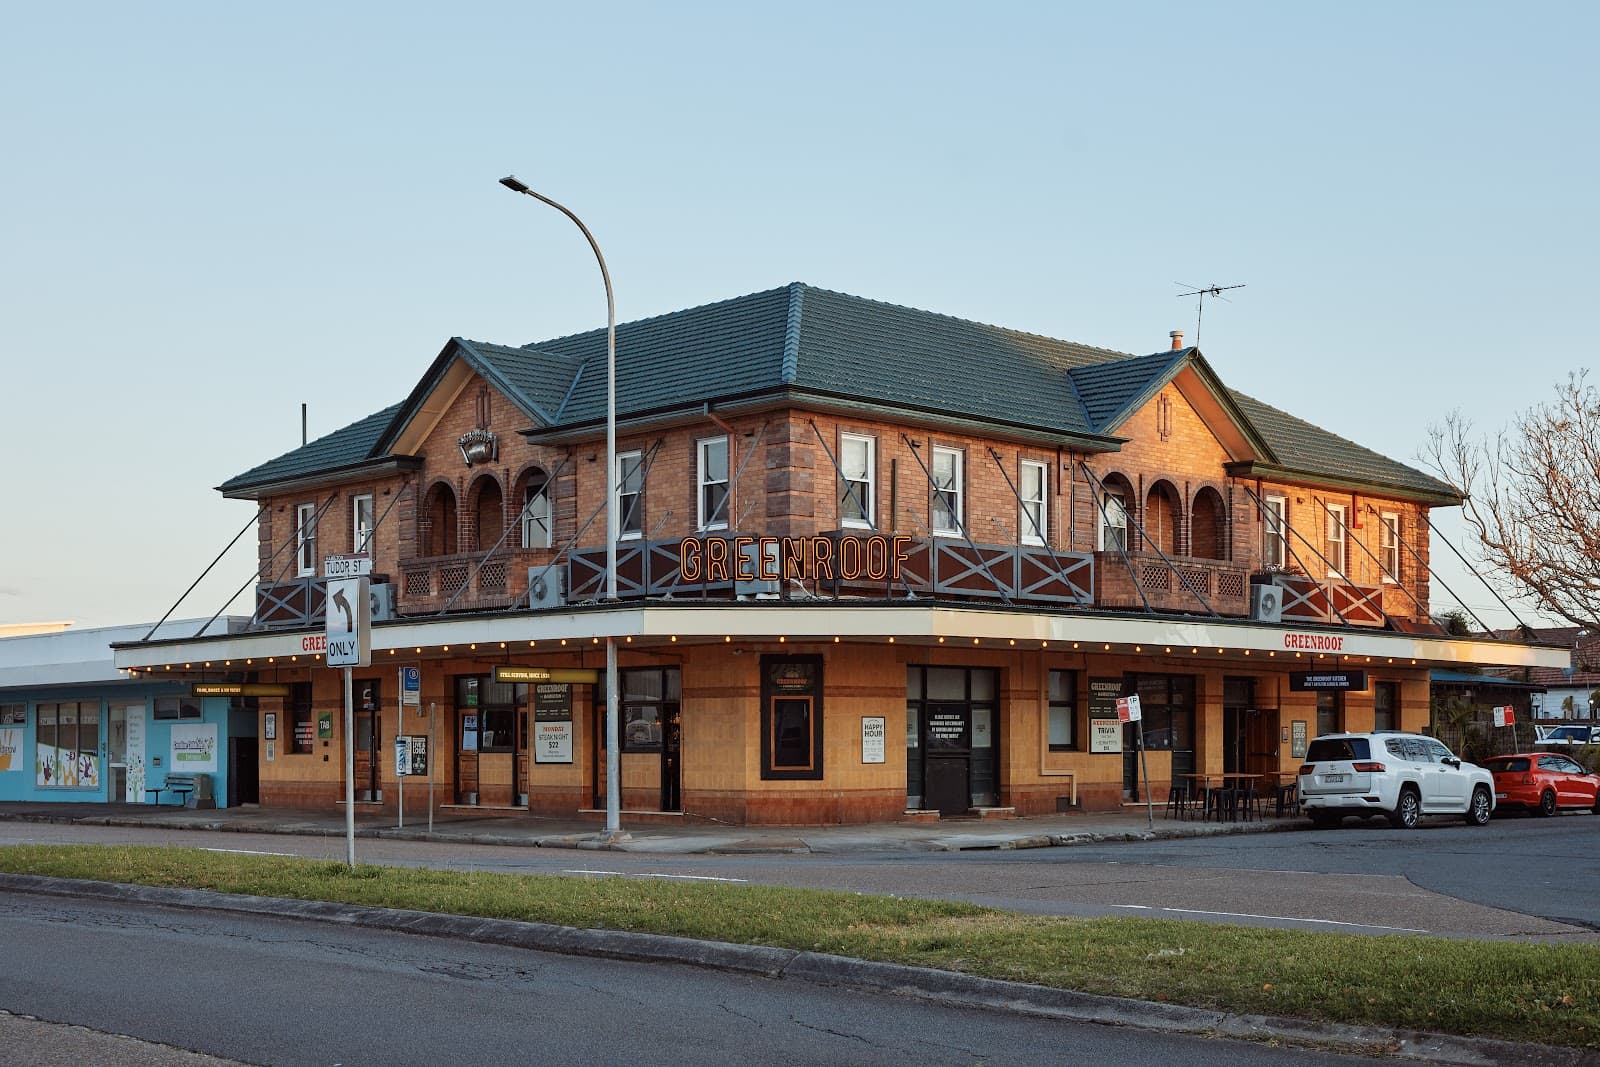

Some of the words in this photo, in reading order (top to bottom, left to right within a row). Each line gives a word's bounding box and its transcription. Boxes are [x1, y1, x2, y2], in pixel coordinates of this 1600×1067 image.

[679, 535, 912, 582] GREENROOF
[326, 561, 350, 574] TUDOR
[353, 560, 362, 573] ST
[302, 636, 326, 651] GREE
[329, 640, 355, 657] ONLY
[1284, 633, 1344, 651] GREENROOF
[320, 720, 330, 729] TAB
[1098, 727, 1115, 735] TRIVIA
